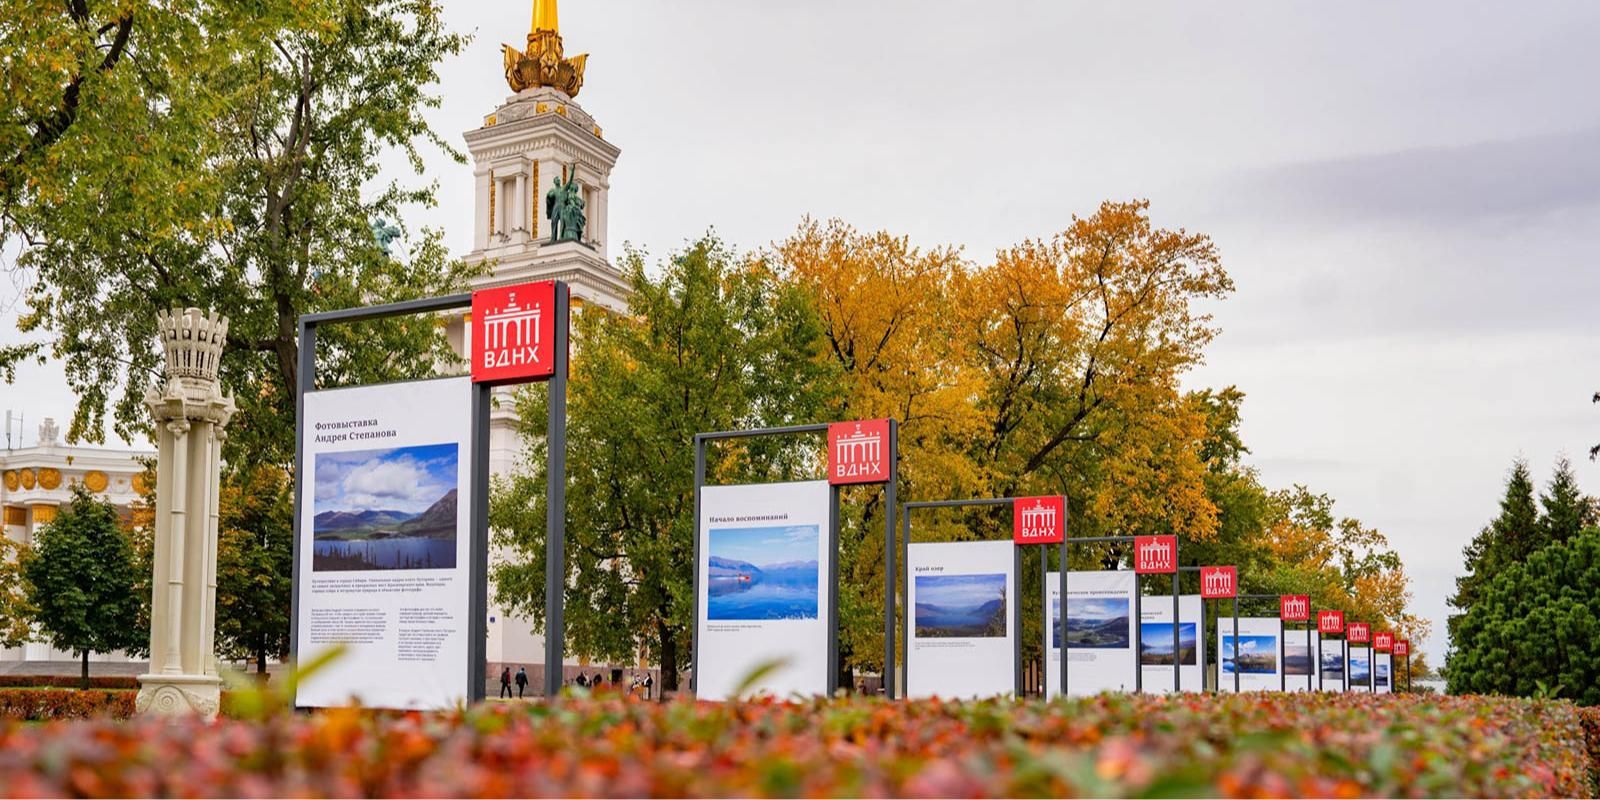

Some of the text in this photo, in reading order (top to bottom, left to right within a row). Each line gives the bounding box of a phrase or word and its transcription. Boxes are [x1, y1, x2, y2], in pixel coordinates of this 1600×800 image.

[484, 346, 540, 368] ВДНХ
[315, 419, 378, 430] Фотовыставка
[315, 430, 397, 443] Андрея Степанова
[837, 461, 881, 477] ВДНХ
[736, 513, 788, 522] воспоминаний
[1022, 527, 1056, 537] ВДНХ
[1141, 561, 1170, 569] ВДНХ
[1206, 587, 1231, 595] ВДНХ
